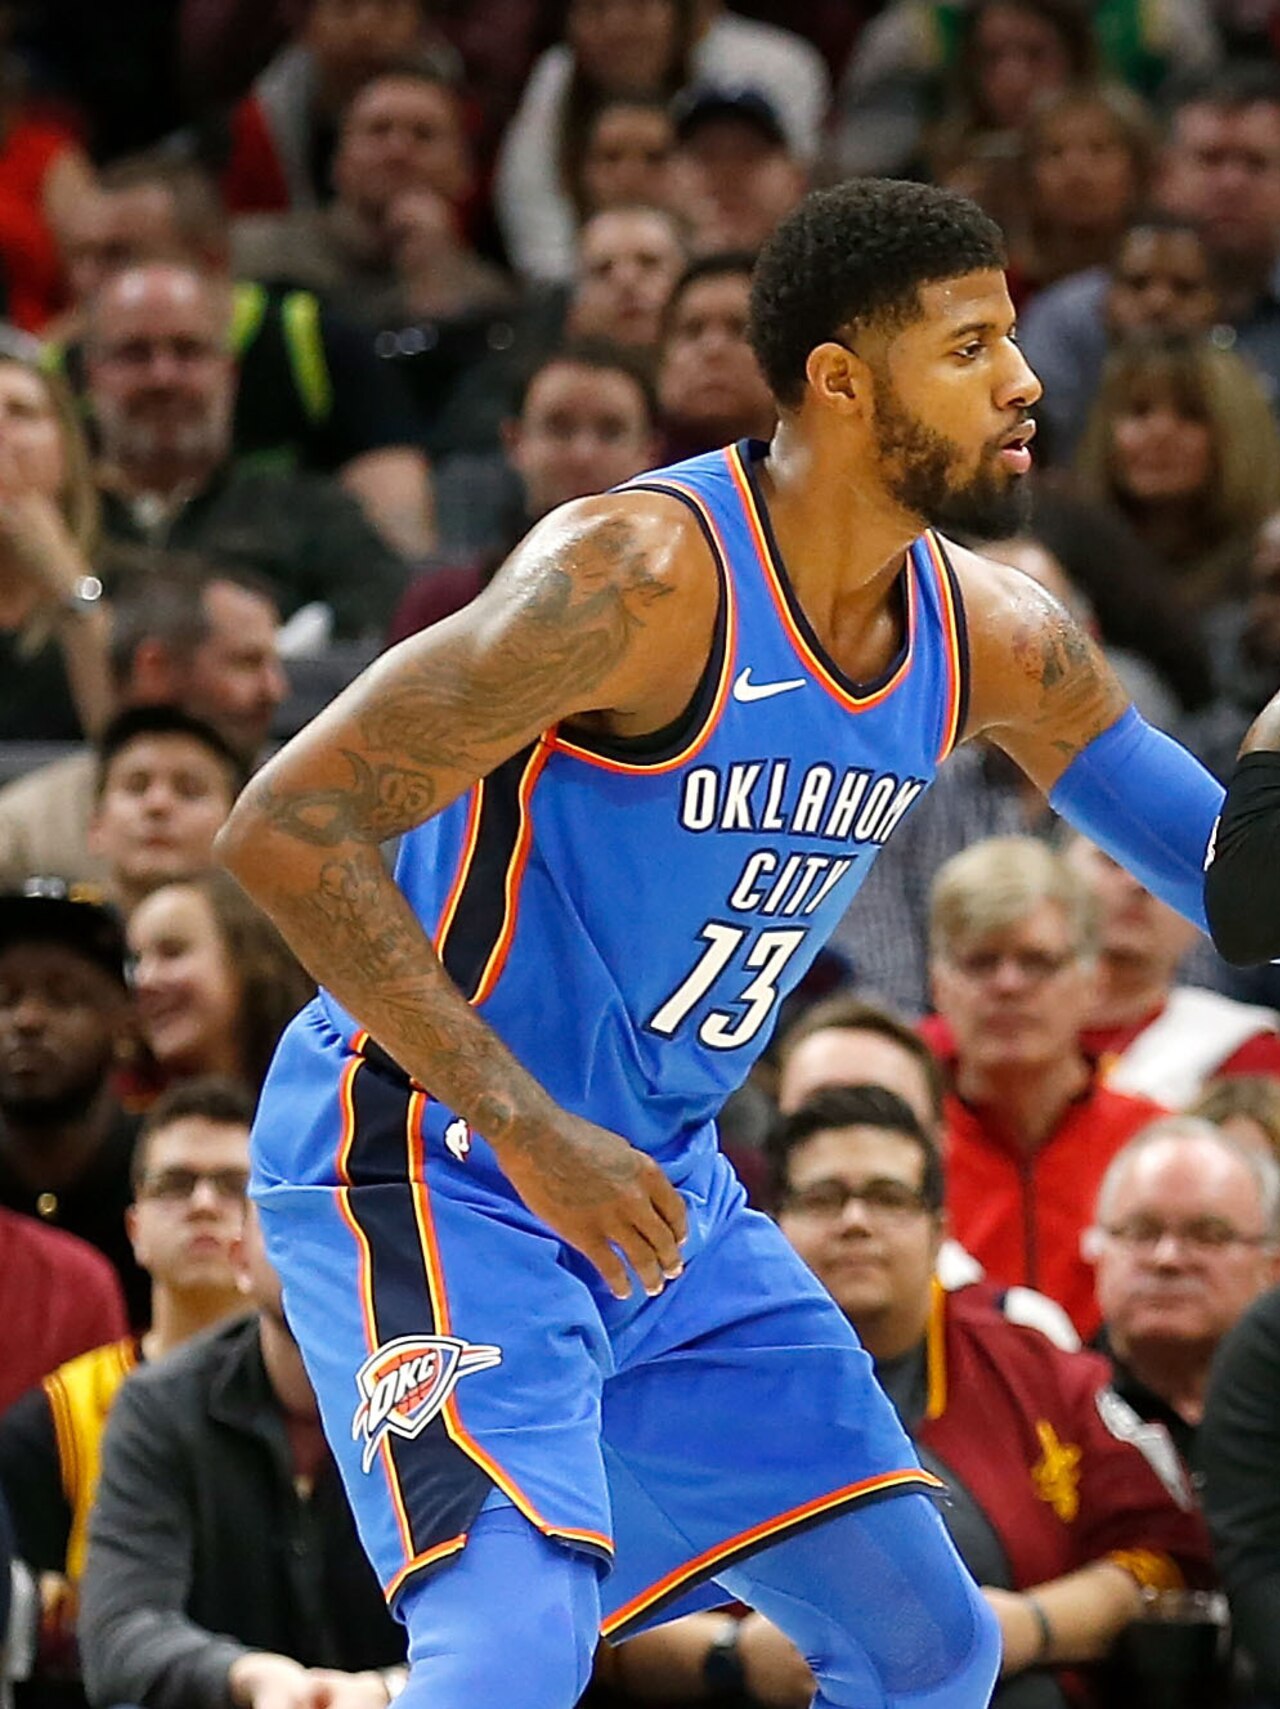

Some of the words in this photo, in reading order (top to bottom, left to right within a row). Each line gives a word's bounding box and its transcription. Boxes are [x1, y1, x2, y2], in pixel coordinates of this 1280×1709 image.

[726, 847, 859, 918] CITY
[642, 918, 811, 1050] 13
[368, 1351, 438, 1434] OKC
